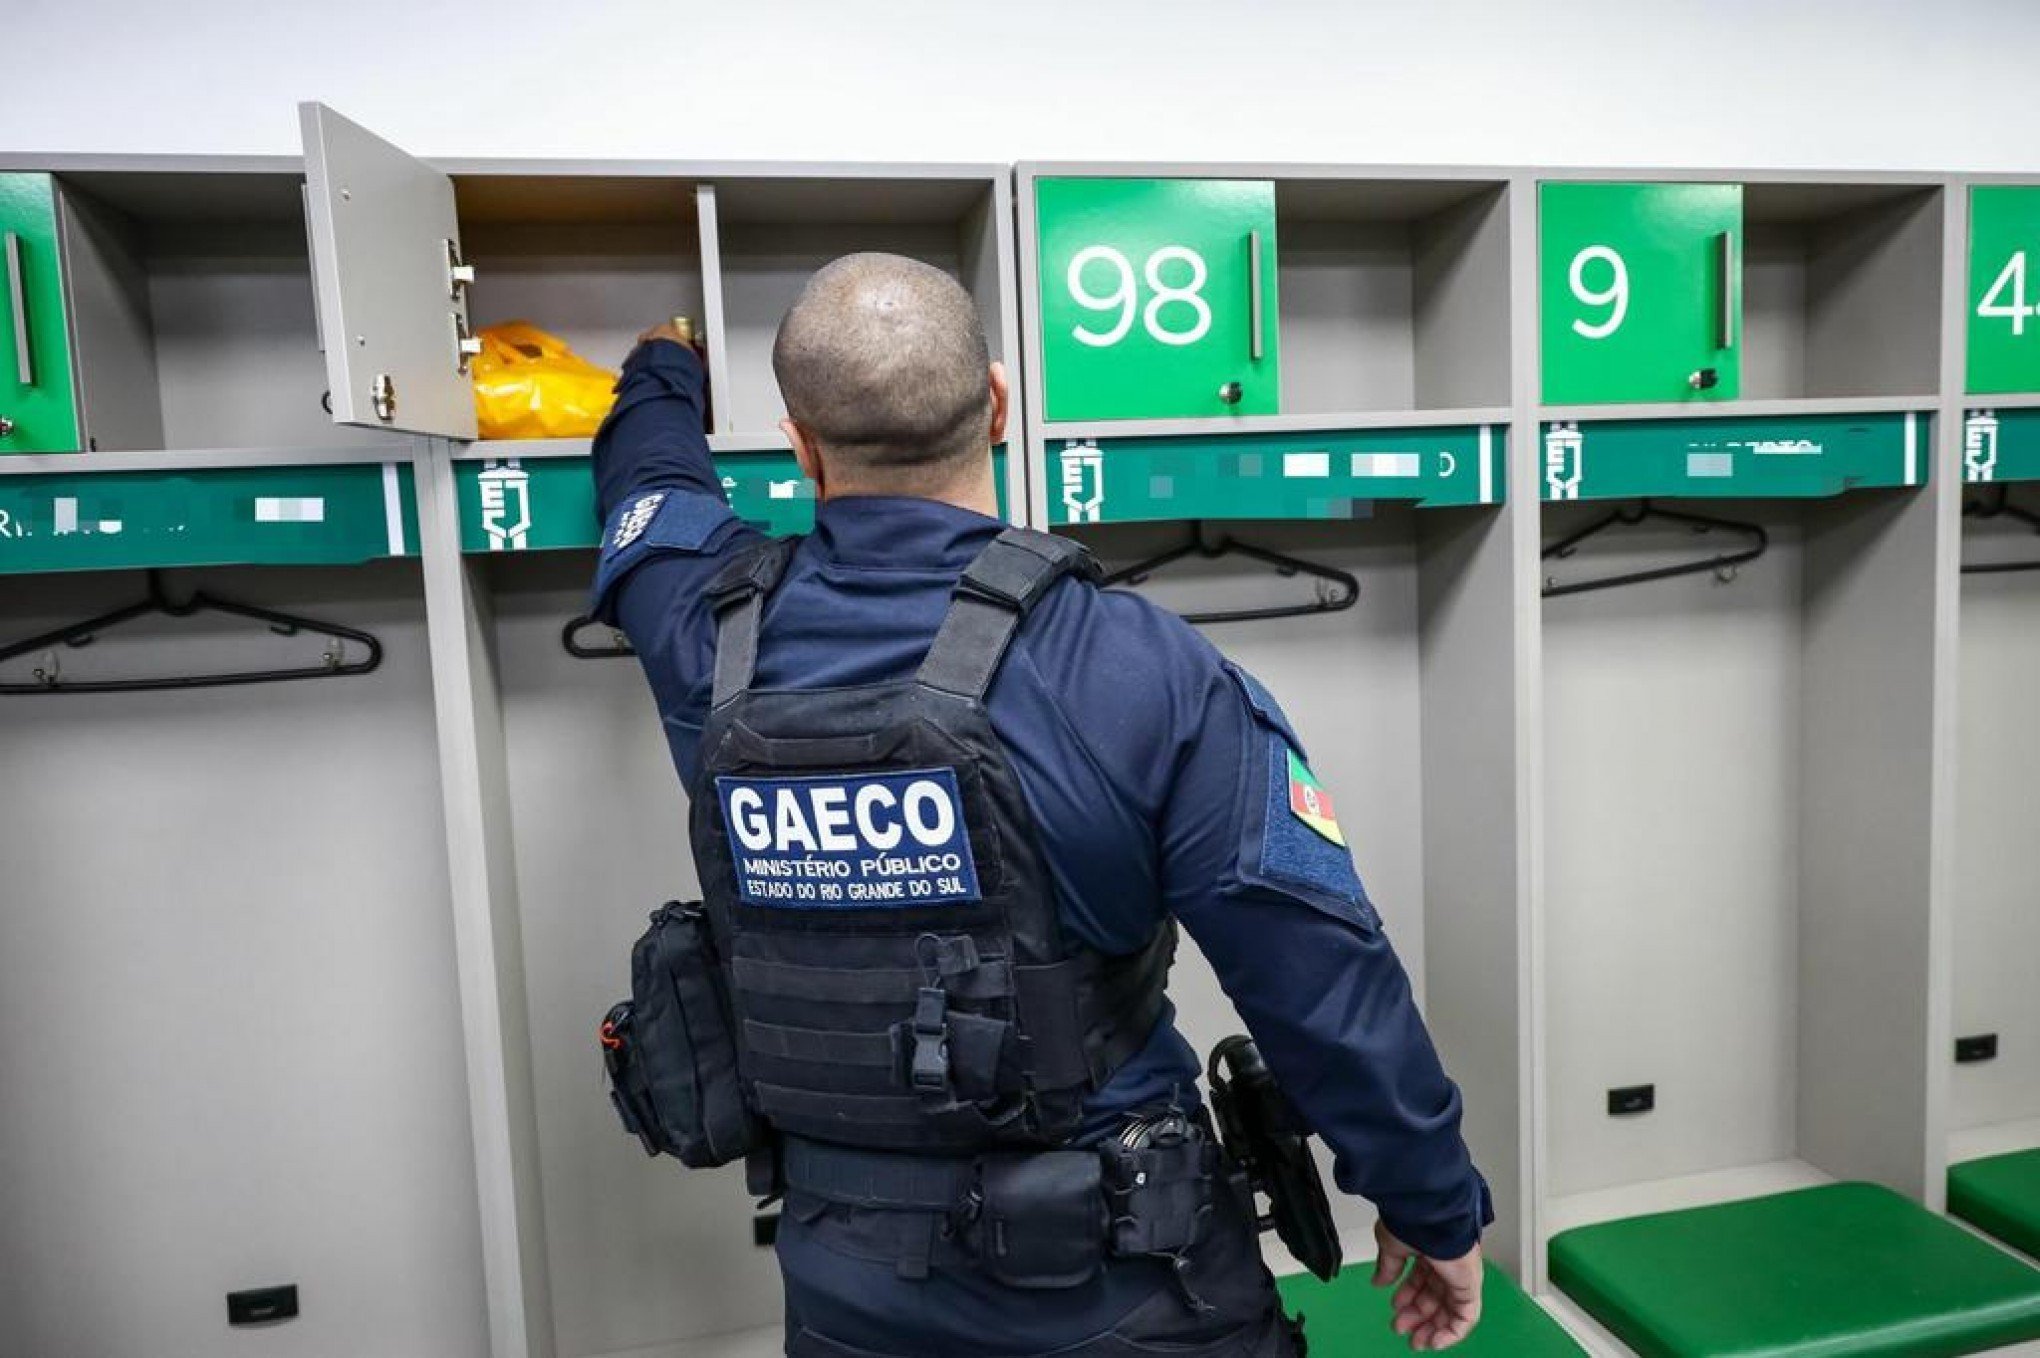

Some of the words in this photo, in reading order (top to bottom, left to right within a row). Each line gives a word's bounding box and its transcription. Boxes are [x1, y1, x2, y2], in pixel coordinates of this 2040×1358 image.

[1067, 244, 1212, 347] 98
[1569, 244, 1629, 339] 9
[1977, 250, 2040, 335] 4
[730, 780, 955, 850] GAECO
[743, 854, 851, 878] MINISTÉRIO
[860, 852, 961, 876] PÚBLICO
[747, 880, 793, 898] ESTADO
[797, 882, 815, 899] DO
[820, 883, 843, 900] RIO
[848, 882, 904, 900] GRANDE
[908, 880, 931, 896] DO
[937, 876, 966, 894] SUL
